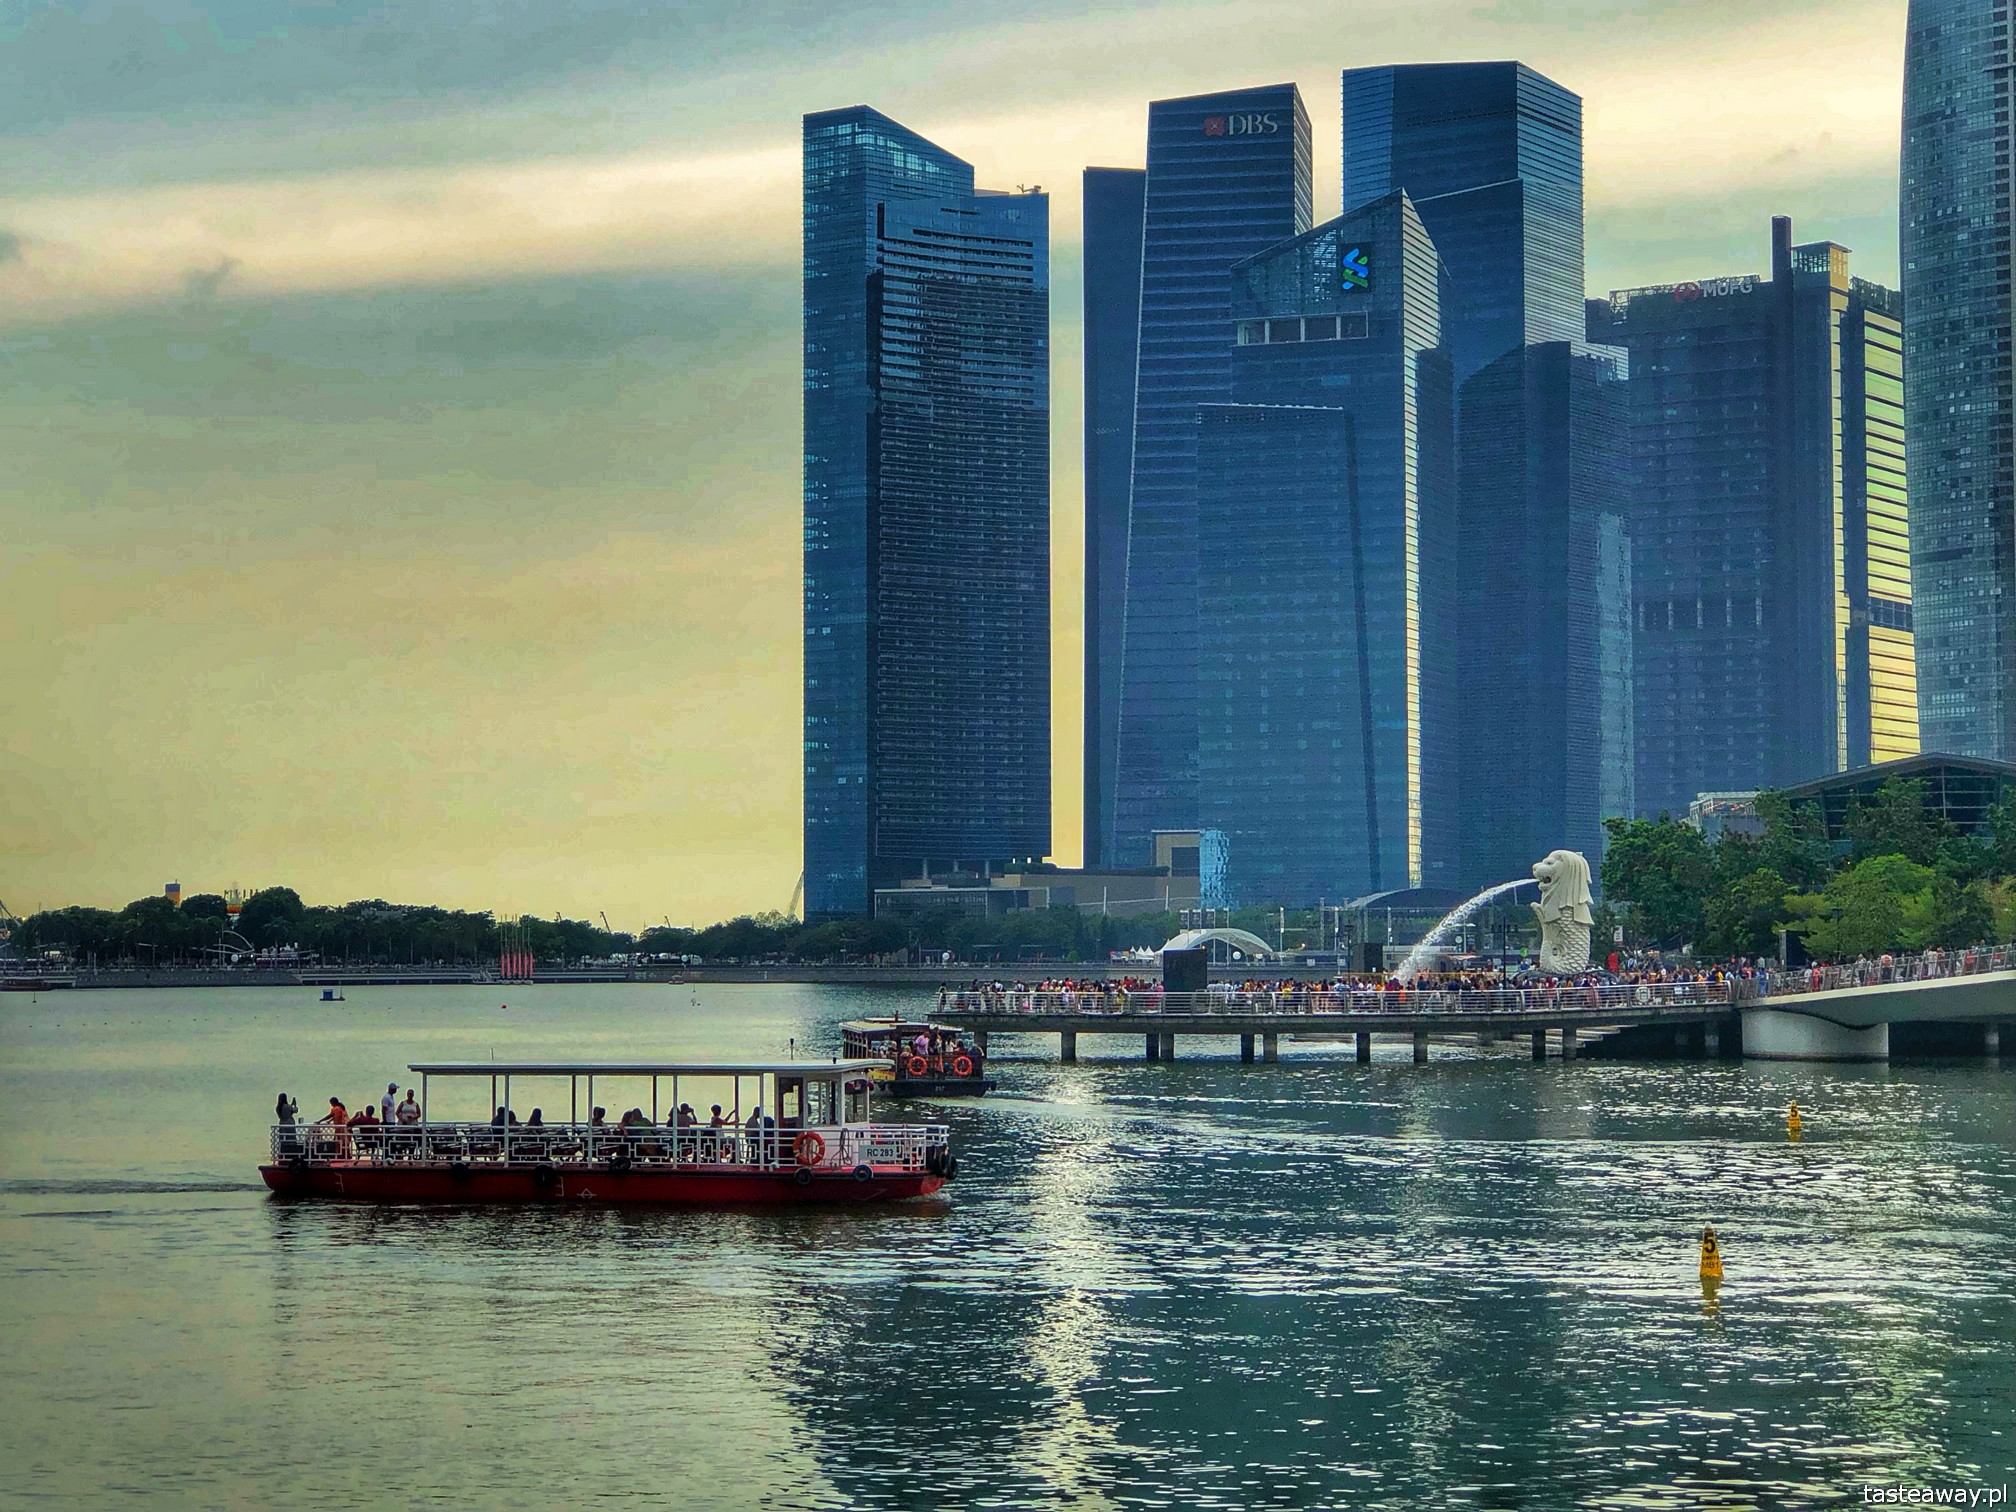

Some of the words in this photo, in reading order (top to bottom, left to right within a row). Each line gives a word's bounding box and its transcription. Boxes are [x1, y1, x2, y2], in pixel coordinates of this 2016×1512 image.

[1228, 113, 1278, 135] DBS
[1703, 281, 1753, 297] MUFG
[1791, 1106, 1798, 1117] 5
[867, 1149, 878, 1157] RC
[880, 1149, 894, 1157] 283
[1704, 1232, 1716, 1253] 5
